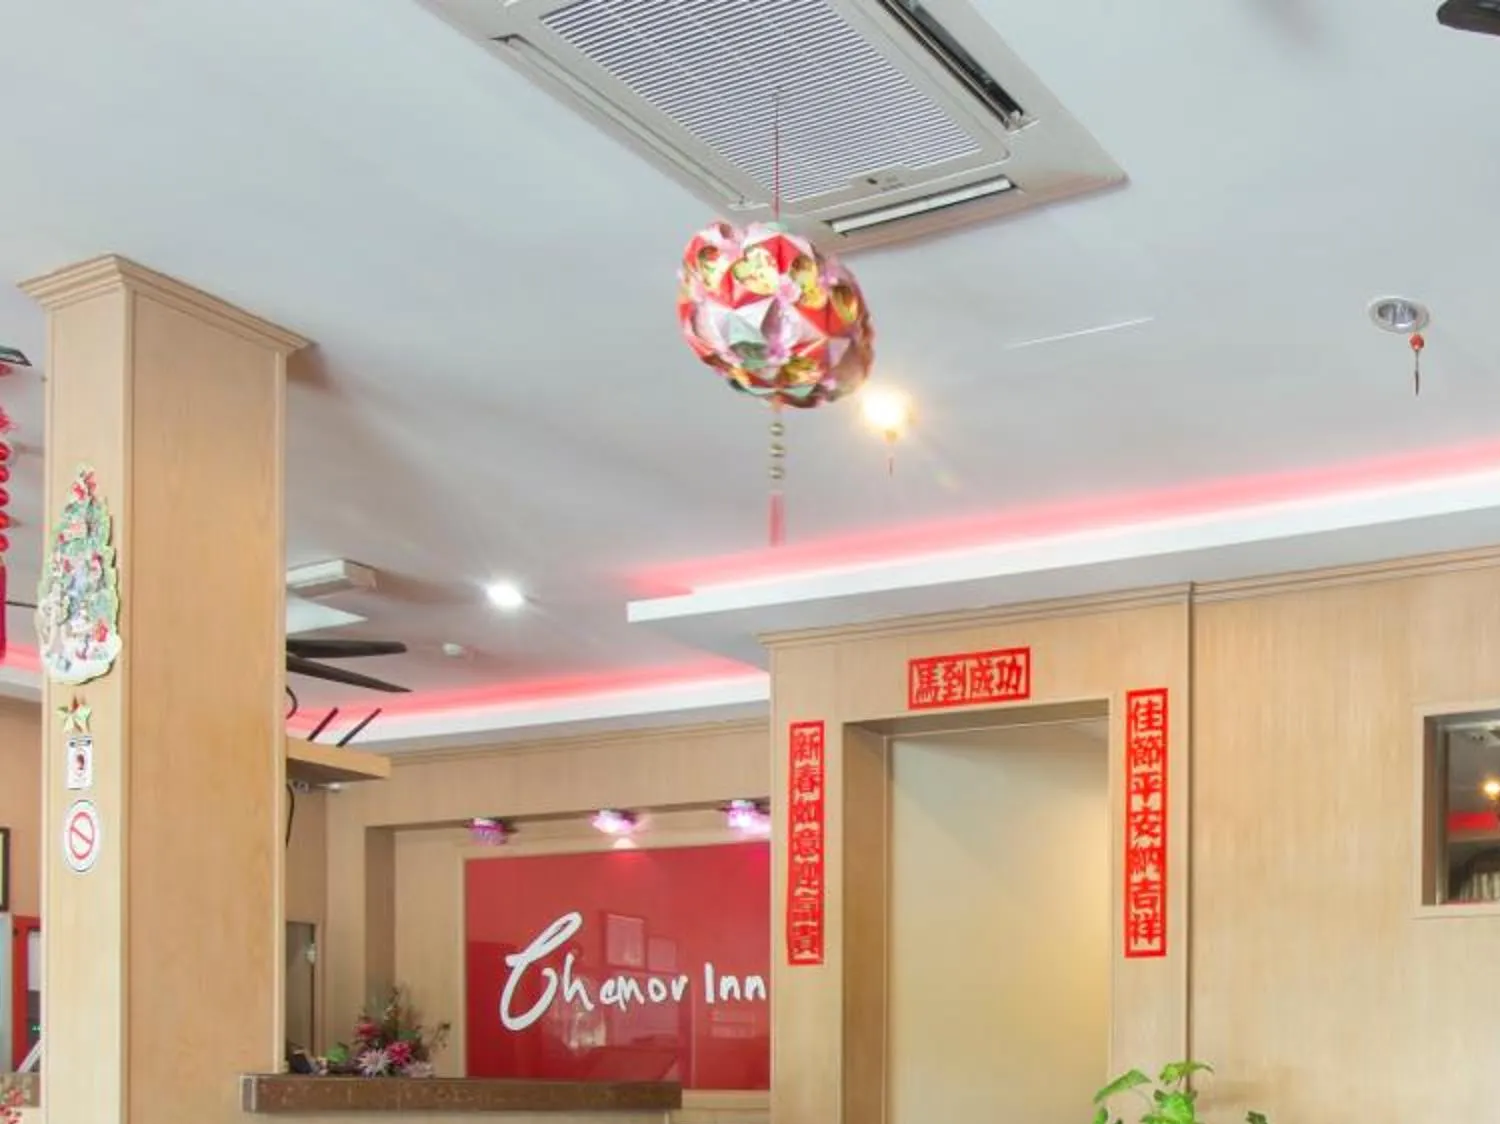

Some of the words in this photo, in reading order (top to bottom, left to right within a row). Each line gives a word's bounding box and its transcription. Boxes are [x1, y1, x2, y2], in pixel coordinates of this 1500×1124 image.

[913, 651, 1027, 707] 馬到成功
[704, 961, 767, 1005] Inn
